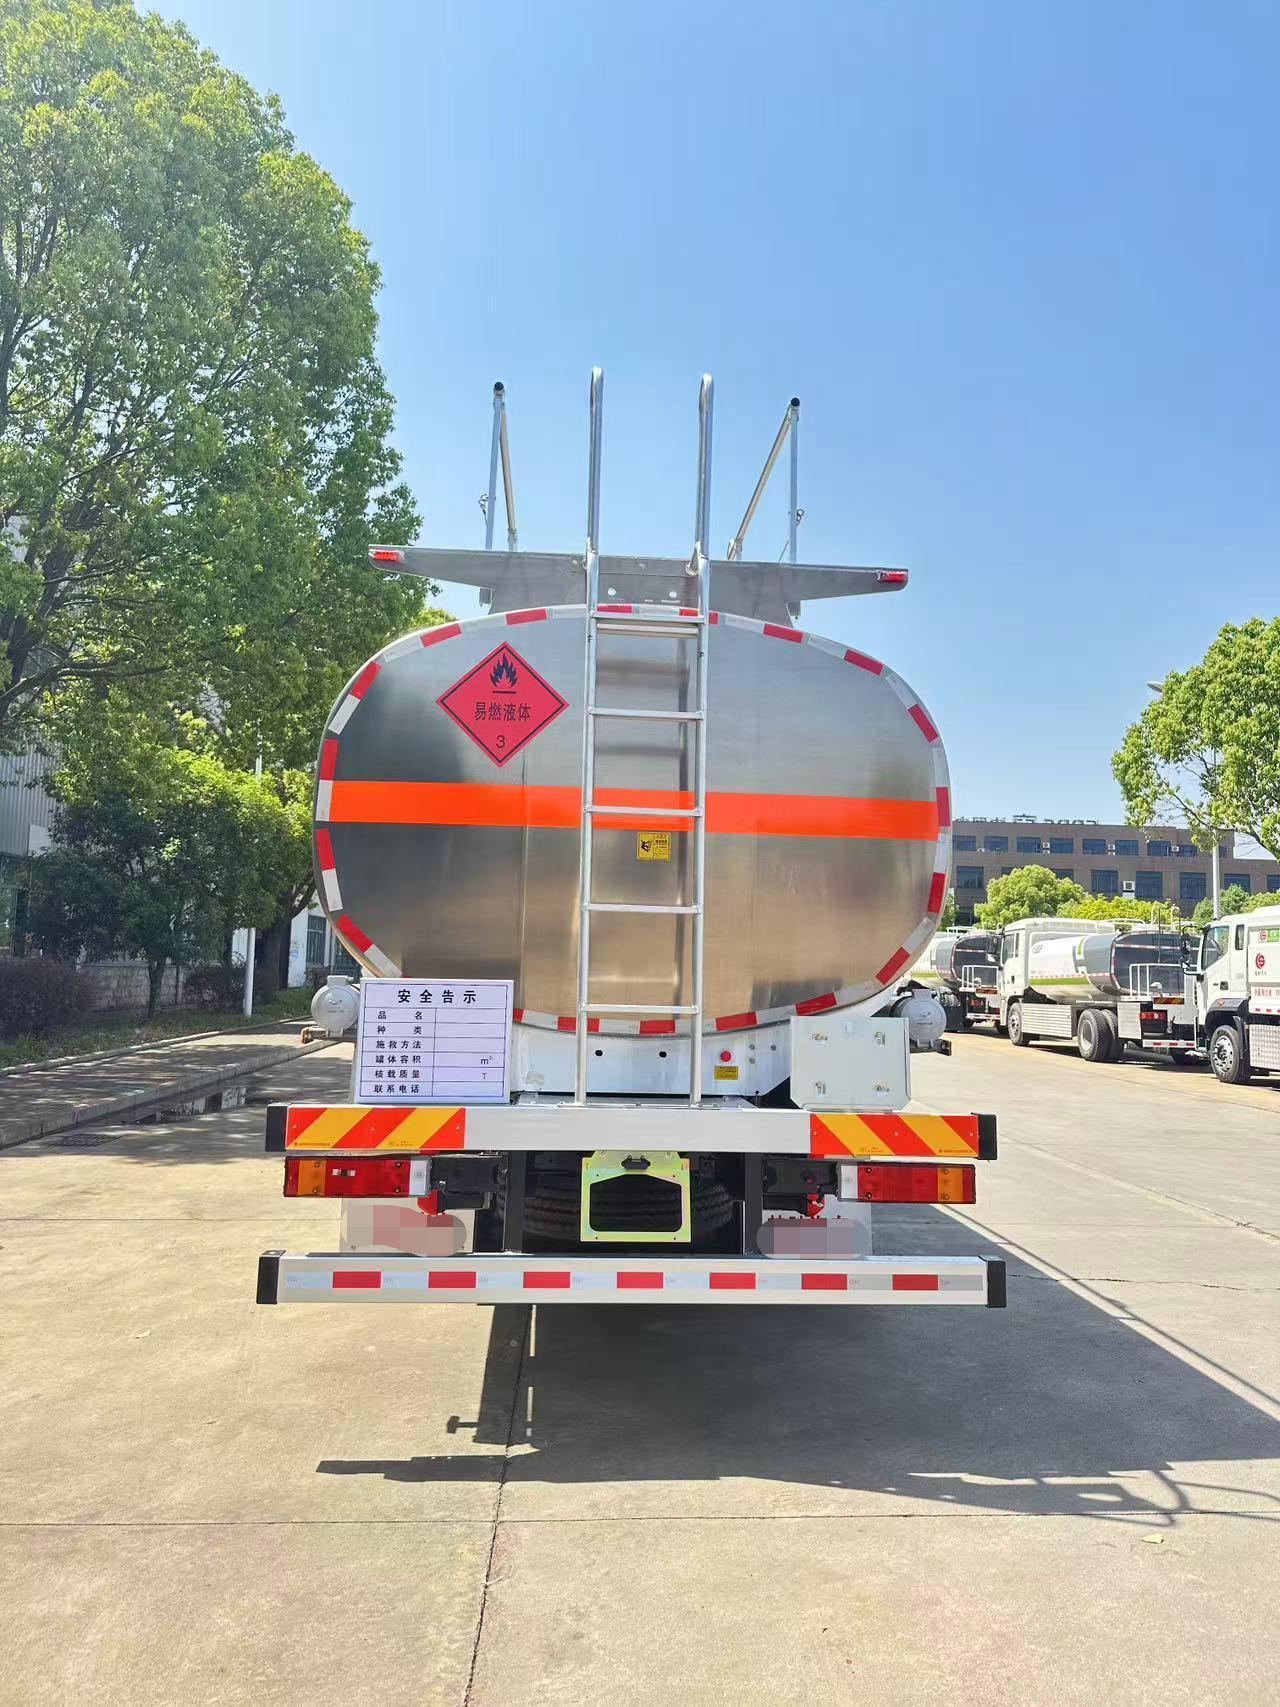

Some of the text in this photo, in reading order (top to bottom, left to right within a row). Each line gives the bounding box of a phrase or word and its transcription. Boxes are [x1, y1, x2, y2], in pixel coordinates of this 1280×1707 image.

[474, 701, 531, 722] 易燃液体
[496, 734, 506, 749] 3
[397, 989, 477, 1004] 安全告示
[376, 1040, 422, 1050] 施救方法
[375, 1054, 421, 1064] 罐体容积
[374, 1069, 421, 1079] 核载质量
[374, 1084, 420, 1094] 联系电话
